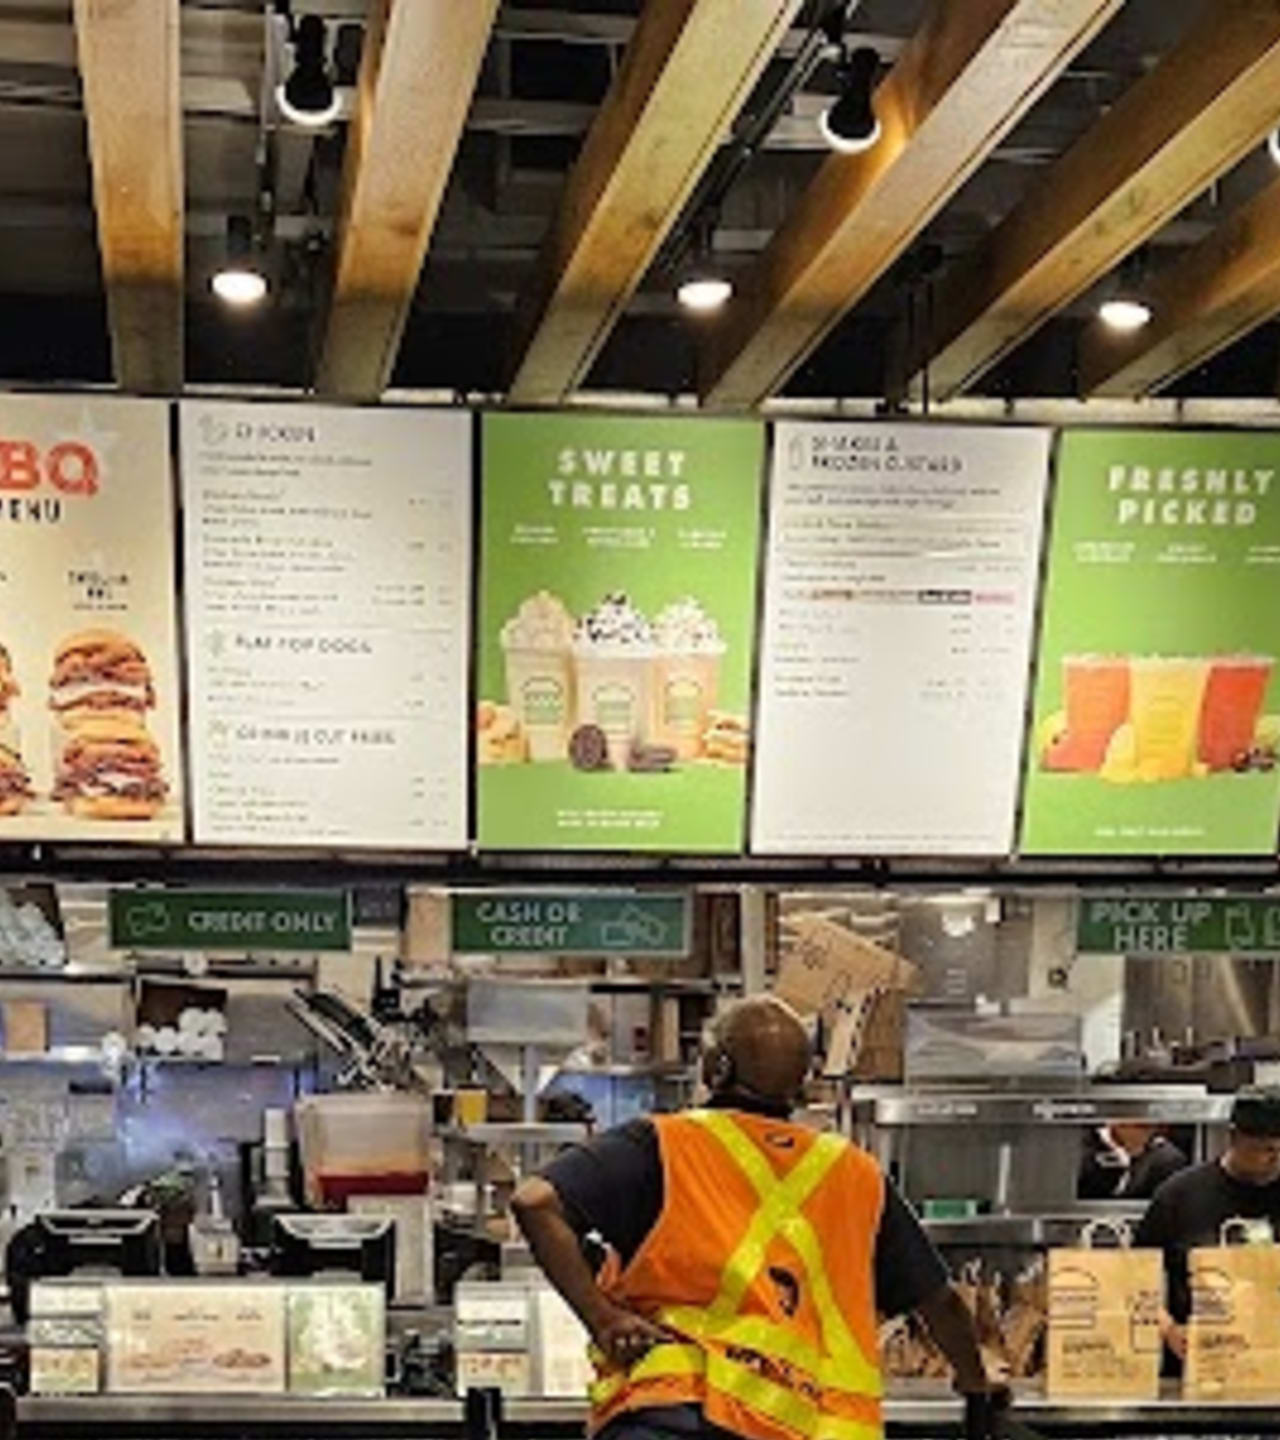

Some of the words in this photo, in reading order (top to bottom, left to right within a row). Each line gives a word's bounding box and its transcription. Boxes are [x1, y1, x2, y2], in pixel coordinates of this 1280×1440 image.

[558, 449, 686, 477] SWEET
[1109, 465, 1276, 494] FRESHLY
[548, 480, 690, 510] TREATS
[1118, 499, 1258, 526] PICKED
[188, 911, 266, 932] CREDIT
[272, 911, 337, 932] ONLY
[476, 902, 540, 922] CASH
[545, 902, 582, 922] OR
[1091, 902, 1160, 923] PICK
[1171, 902, 1212, 924] UP
[490, 926, 568, 945] CREDIT
[1114, 926, 1188, 950] HERE
